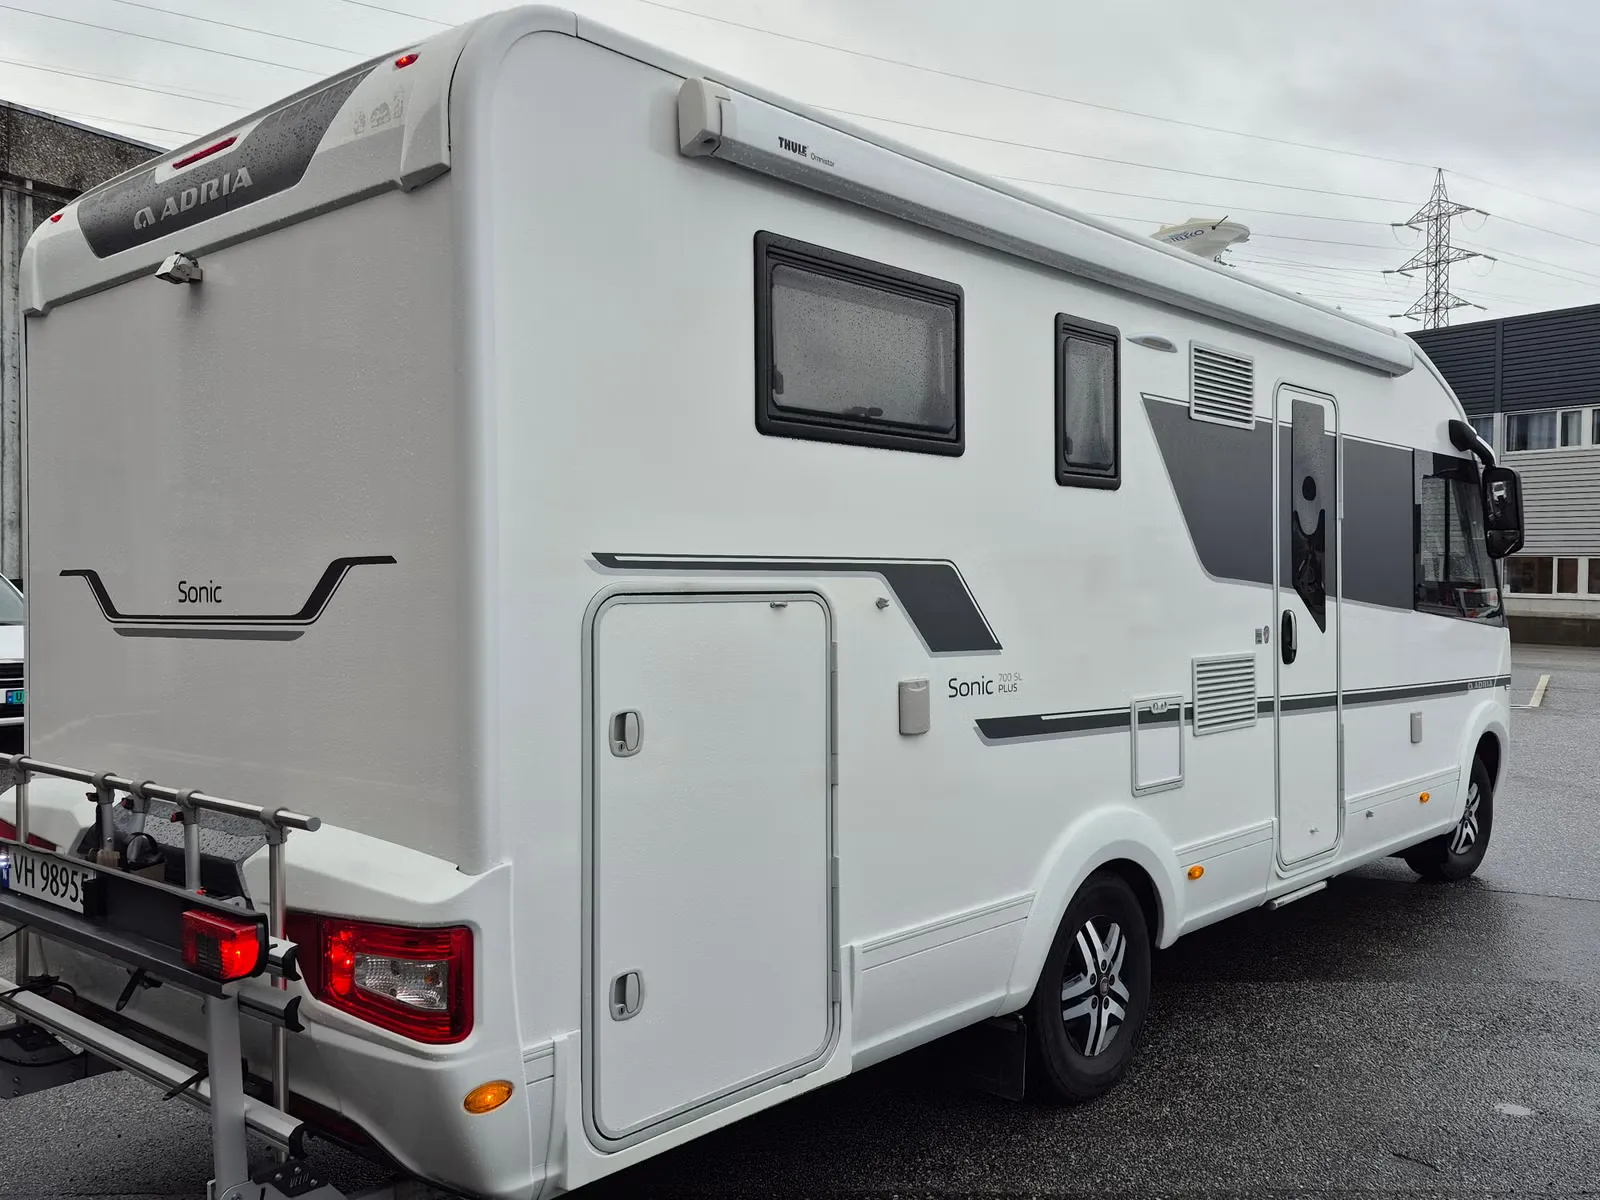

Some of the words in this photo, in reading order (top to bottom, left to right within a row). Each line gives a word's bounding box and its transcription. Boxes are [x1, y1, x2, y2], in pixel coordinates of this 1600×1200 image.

[778, 136, 807, 157] THULE
[160, 166, 253, 221] ADRIA
[178, 580, 222, 603] Sonic
[948, 675, 994, 698] Sonic
[998, 672, 1012, 682] 700
[998, 683, 1018, 693] PLUS
[13, 852, 35, 889] VH
